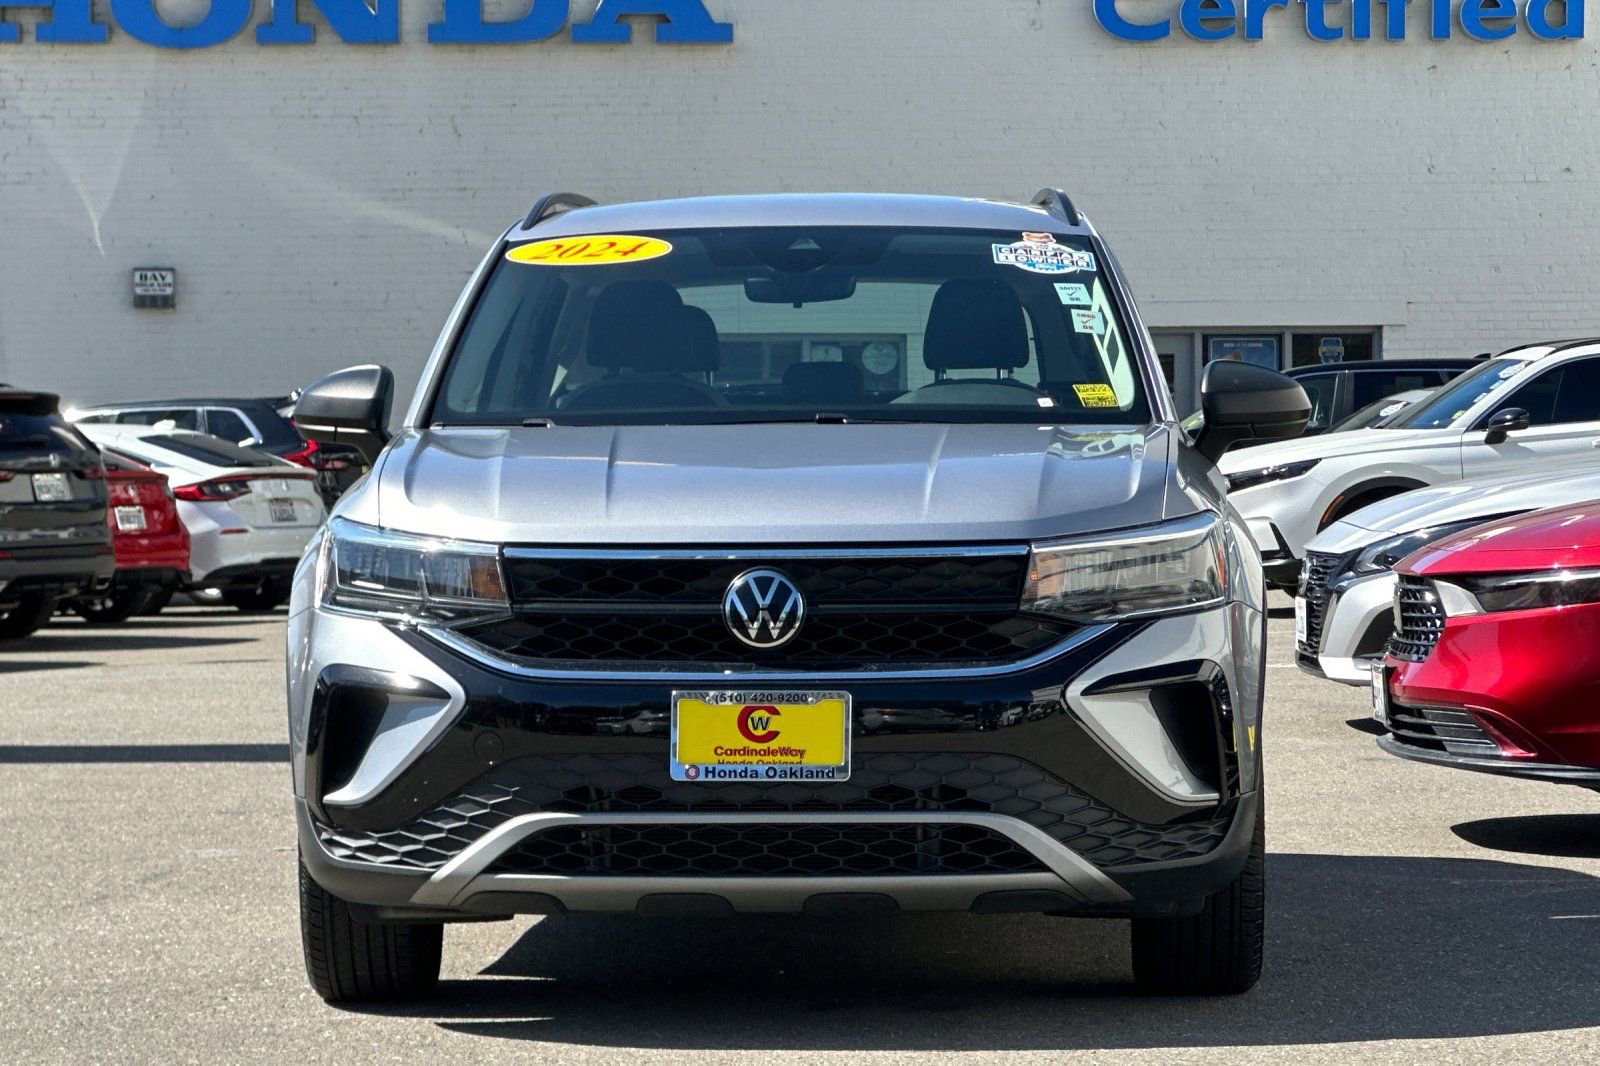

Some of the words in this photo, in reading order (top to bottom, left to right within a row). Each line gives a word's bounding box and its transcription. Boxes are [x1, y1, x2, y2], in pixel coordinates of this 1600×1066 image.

[0, 0, 733, 48] ONDA
[530, 240, 650, 259] 2024
[1000, 247, 1086, 262] CARFAX
[1017, 255, 1088, 267] OWNER
[715, 693, 747, 704] (510)
[750, 693, 809, 704] 420-9200
[713, 746, 806, 759] CardinaleWay
[704, 767, 759, 779] Honda
[765, 767, 836, 779] Oakland
